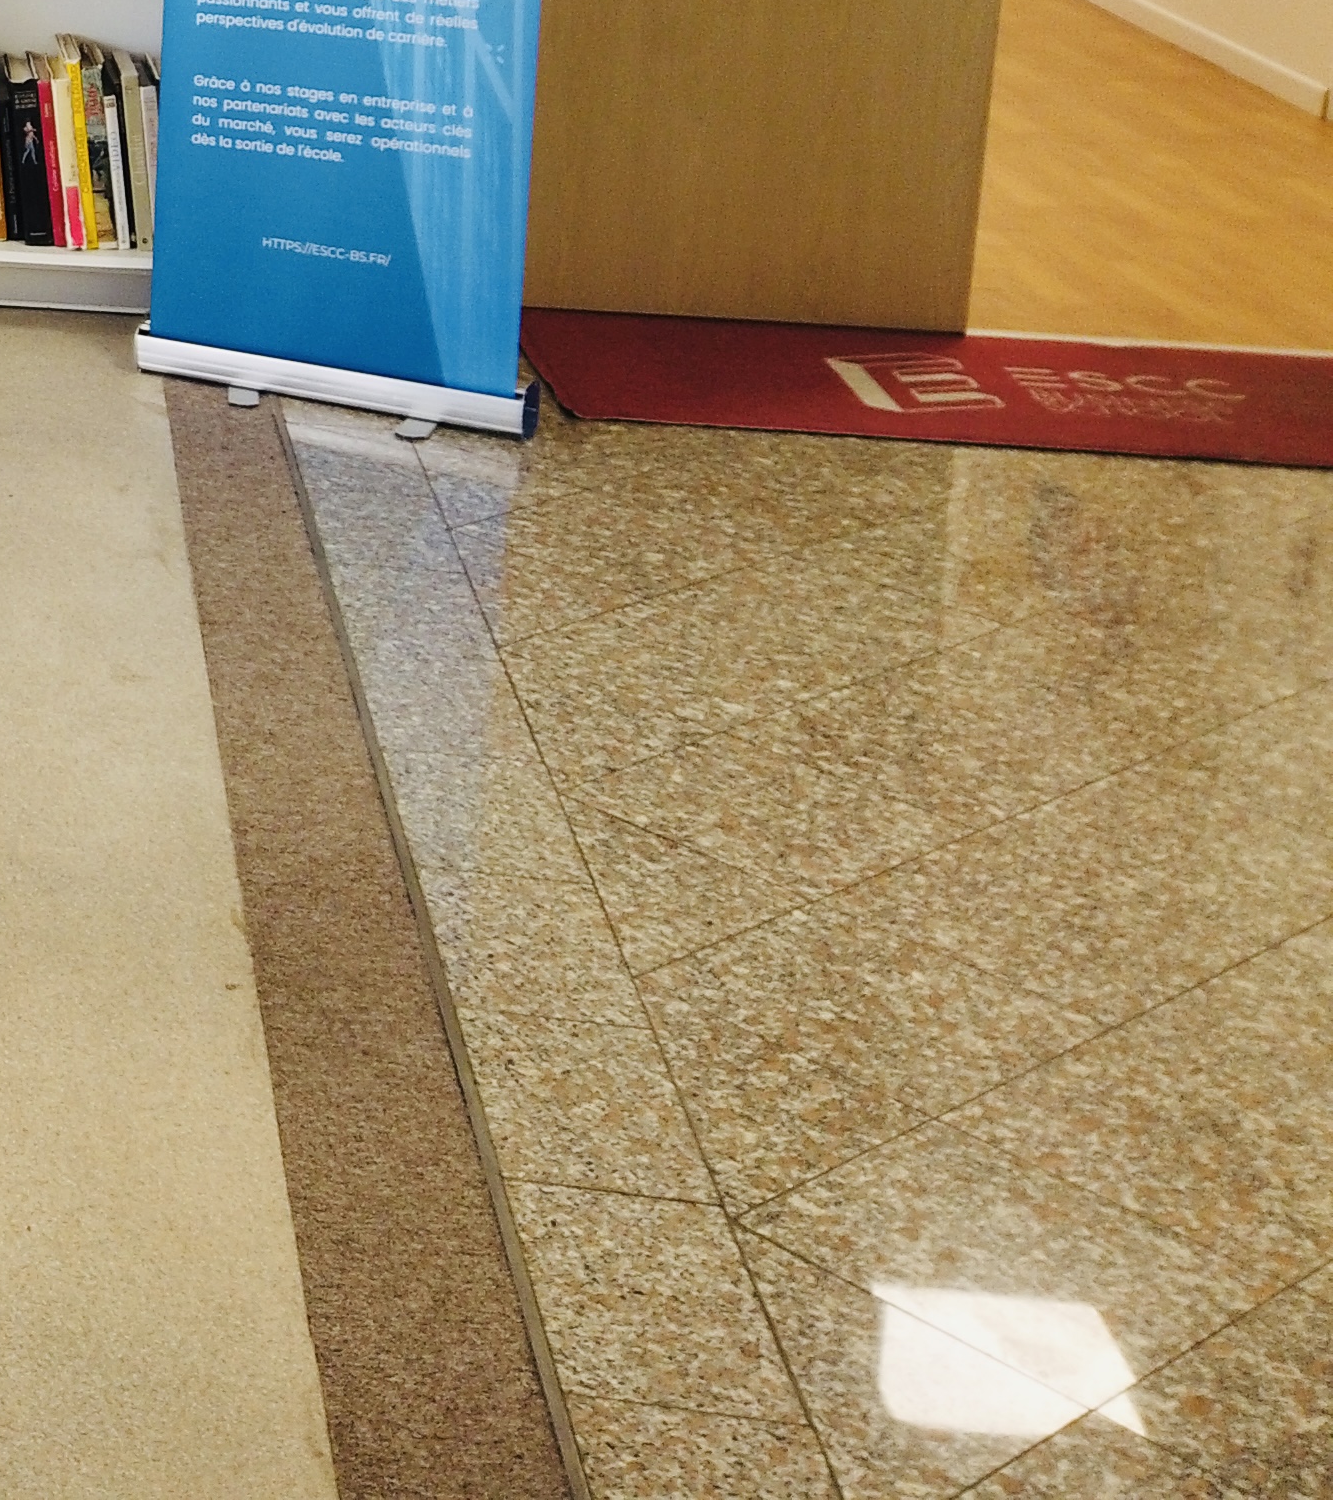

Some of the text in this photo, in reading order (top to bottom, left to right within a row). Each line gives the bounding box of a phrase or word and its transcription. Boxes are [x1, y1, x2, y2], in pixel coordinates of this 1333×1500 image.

[196, 11, 448, 47] perspectives d'évolution de carrière.
[295, 2, 309, 13] et
[315, 4, 347, 17] vous
[353, 6, 399, 22] offrent
[405, 11, 424, 24] de
[430, 13, 478, 30] réelles
[194, 74, 474, 118] Grâce à nos stages en entreprise et à
[193, 95, 472, 138] nos partenariats avec les acteurs clés
[191, 132, 345, 162] dès la sortie de l'école.
[192, 113, 471, 159] du marché, vous serez opérationnels
[1003, 366, 1246, 401] ESCC
